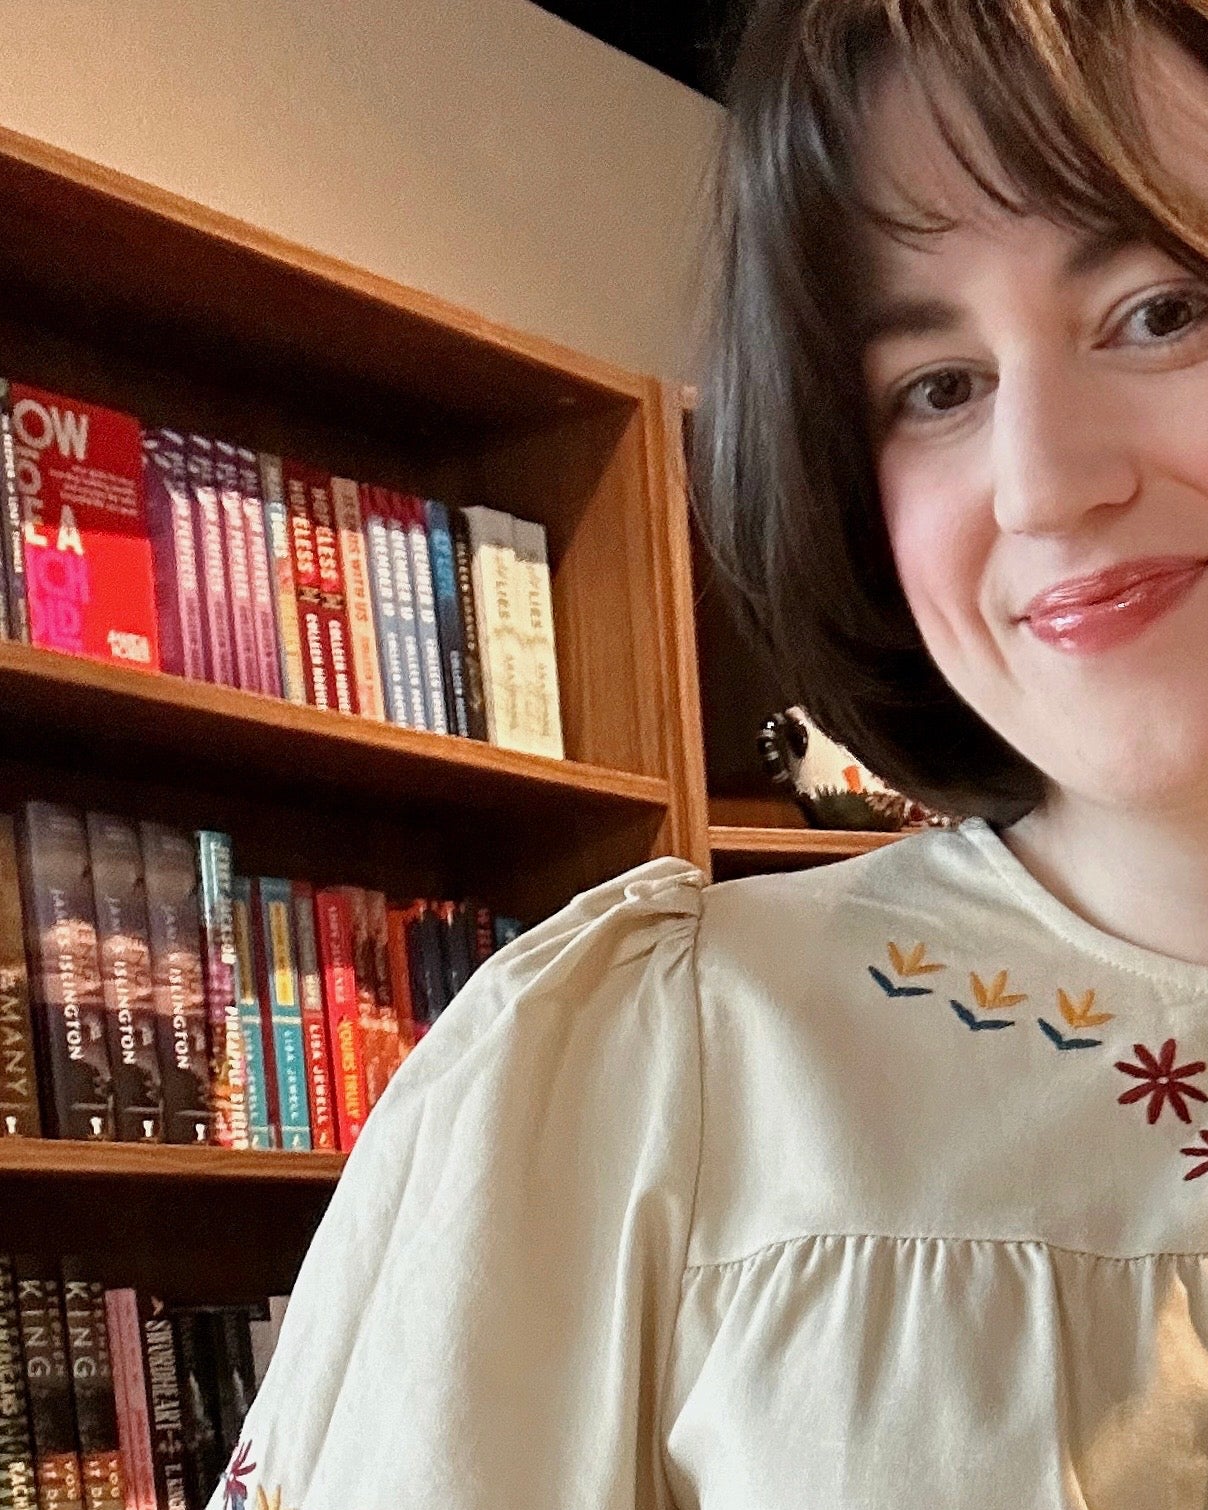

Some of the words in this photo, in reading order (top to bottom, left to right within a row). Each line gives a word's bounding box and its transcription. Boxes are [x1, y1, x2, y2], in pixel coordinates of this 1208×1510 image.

[305, 613, 323, 663] COLLEEN
[327, 620, 346, 669] COLLEEN
[58, 954, 85, 1060] ISLINGTON
[113, 961, 135, 1065] ISLINGTON
[166, 968, 190, 1068] ISLINGTON
[0, 995, 30, 1096] MANY
[221, 1005, 245, 1087] PINEAPPLE
[241, 1029, 254, 1061] LISA
[282, 1030, 296, 1062] LISA
[307, 1023, 324, 1059] LISA
[336, 1019, 357, 1071] YOURS
[245, 1067, 260, 1118] JEWELL
[285, 1068, 301, 1120] JEWELL
[311, 1065, 331, 1125] JEWELL
[342, 1074, 361, 1118] TRULY
[226, 1093, 251, 1149] STREET
[16, 1279, 51, 1378] KING
[63, 1280, 98, 1379] KING
[143, 1319, 182, 1430] SWORDHEART
[42, 1461, 57, 1478] IT
[63, 1460, 77, 1499] YOU
[88, 1460, 100, 1477] IT
[106, 1458, 121, 1498] YOU
